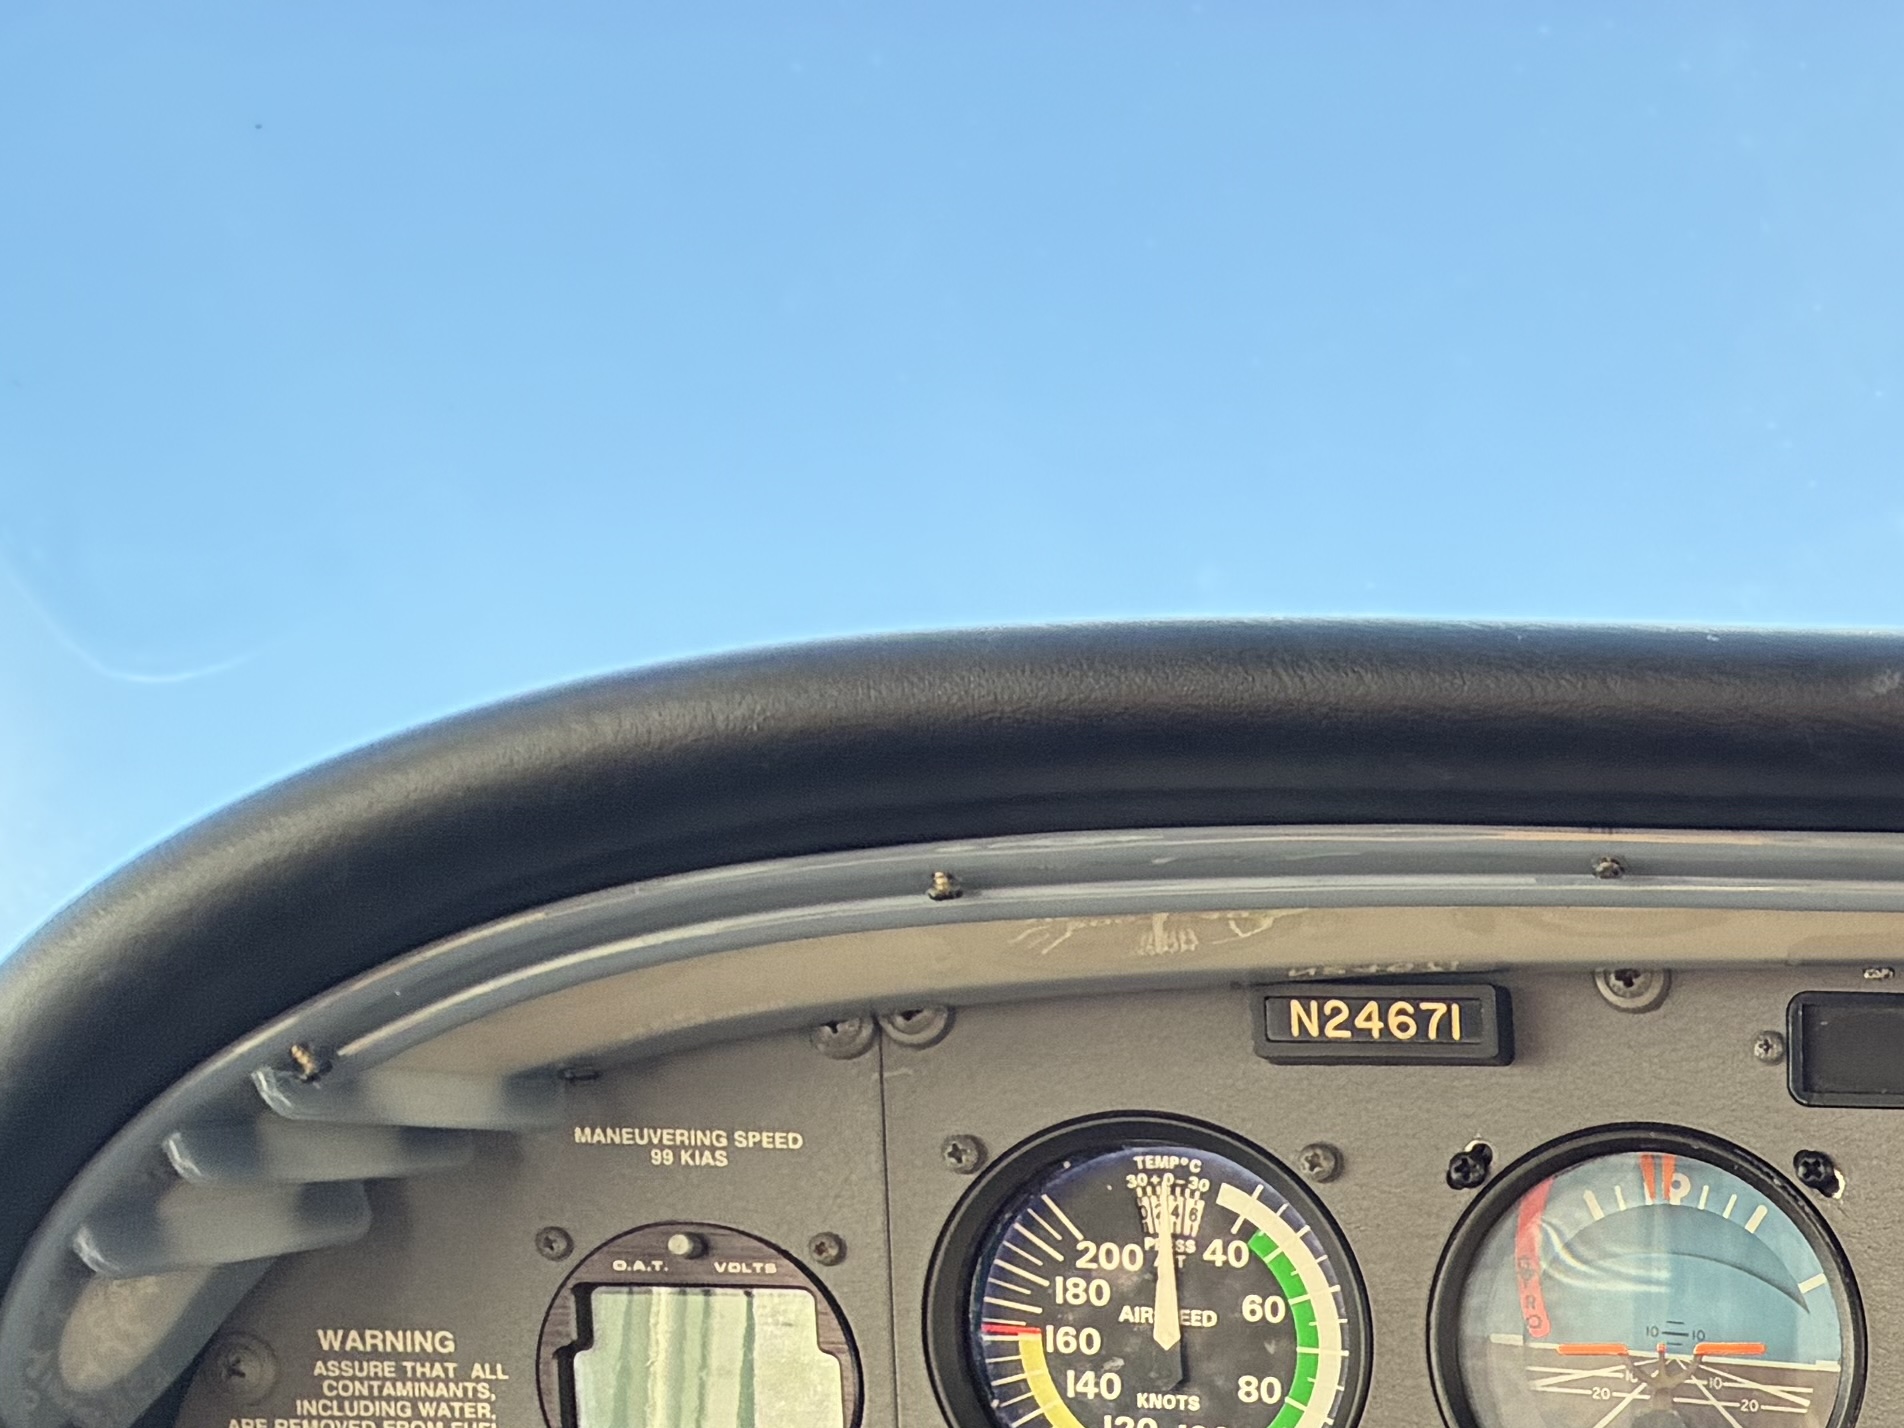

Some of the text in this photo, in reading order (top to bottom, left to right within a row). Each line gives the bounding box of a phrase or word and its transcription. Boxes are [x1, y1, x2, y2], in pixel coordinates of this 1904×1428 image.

[1289, 998, 1461, 1041] N24671
[574, 1126, 804, 1150] MANEUVERING SPEED
[650, 1148, 729, 1168] 99 KIAS
[1074, 1242, 1145, 1270] 200
[1202, 1239, 1254, 1268] 40
[713, 1261, 778, 1275] VOLTS
[1054, 1277, 1111, 1307] 180
[1241, 1295, 1286, 1323] 60
[317, 1328, 456, 1355] WARNING
[1045, 1325, 1102, 1356] 160
[313, 1360, 510, 1381] ASSURE THAT ALL
[322, 1379, 497, 1402] CONTAMINANTS,
[1066, 1371, 1122, 1401] 140
[1237, 1375, 1282, 1404] 80
[1136, 1392, 1201, 1412] KNOTS
